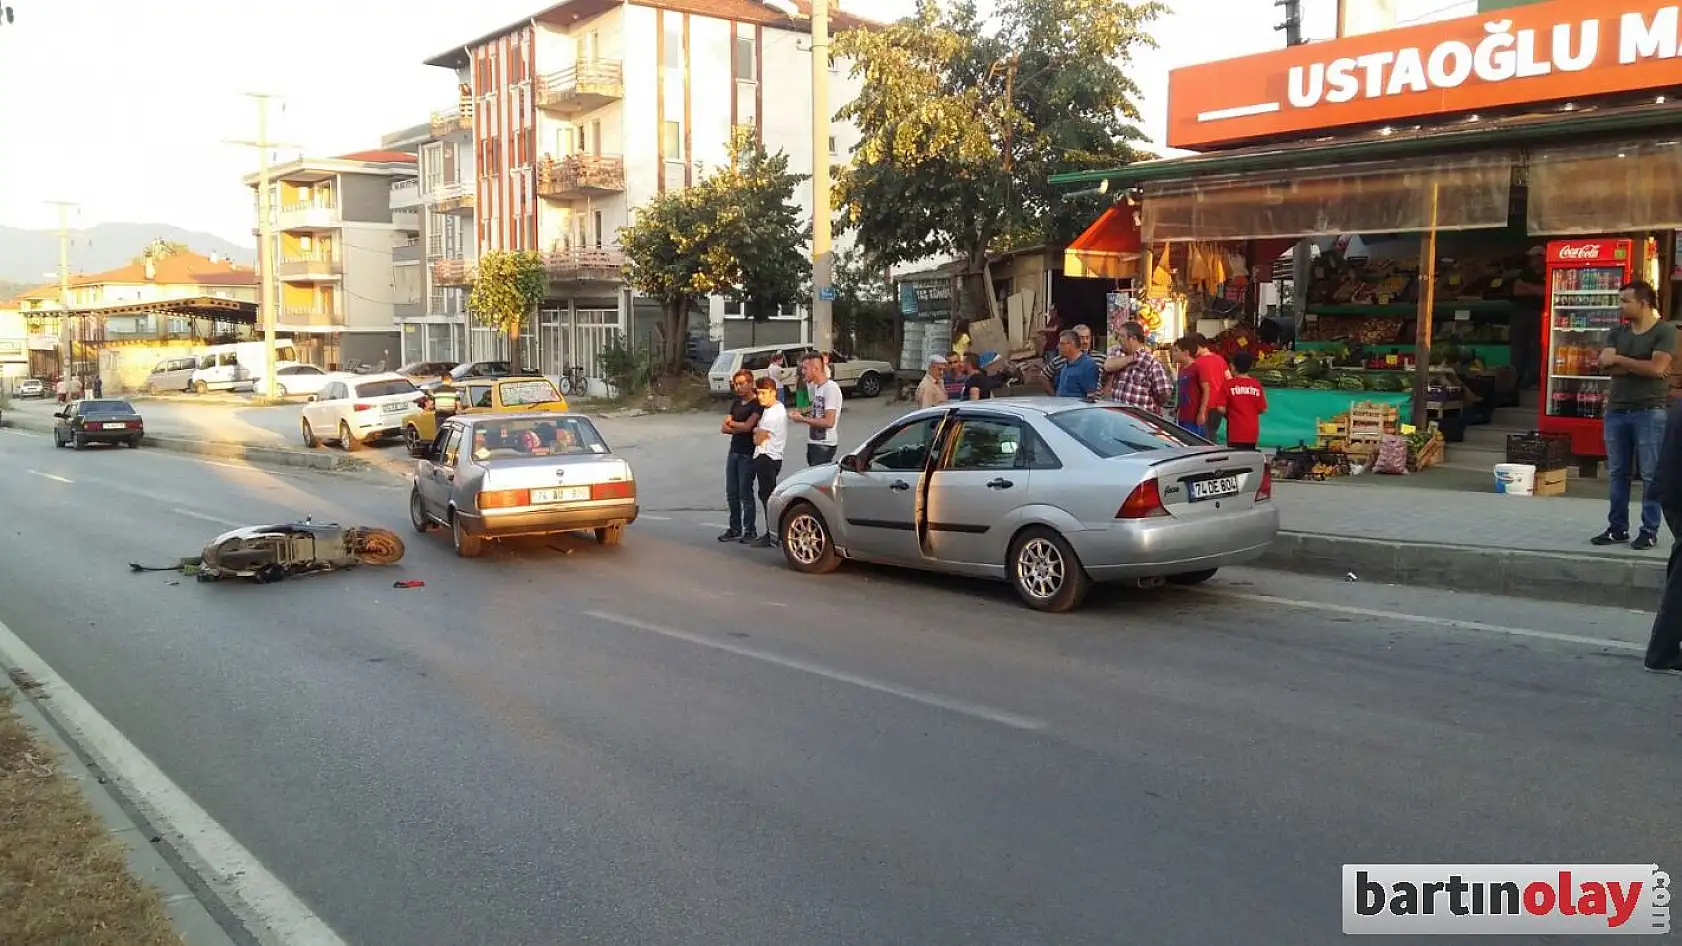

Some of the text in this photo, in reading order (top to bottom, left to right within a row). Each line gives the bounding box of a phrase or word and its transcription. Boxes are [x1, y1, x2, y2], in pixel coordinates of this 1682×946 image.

[1287, 5, 1682, 108] USTAOĞLU M
[1195, 478, 1237, 496] 74 DE 804
